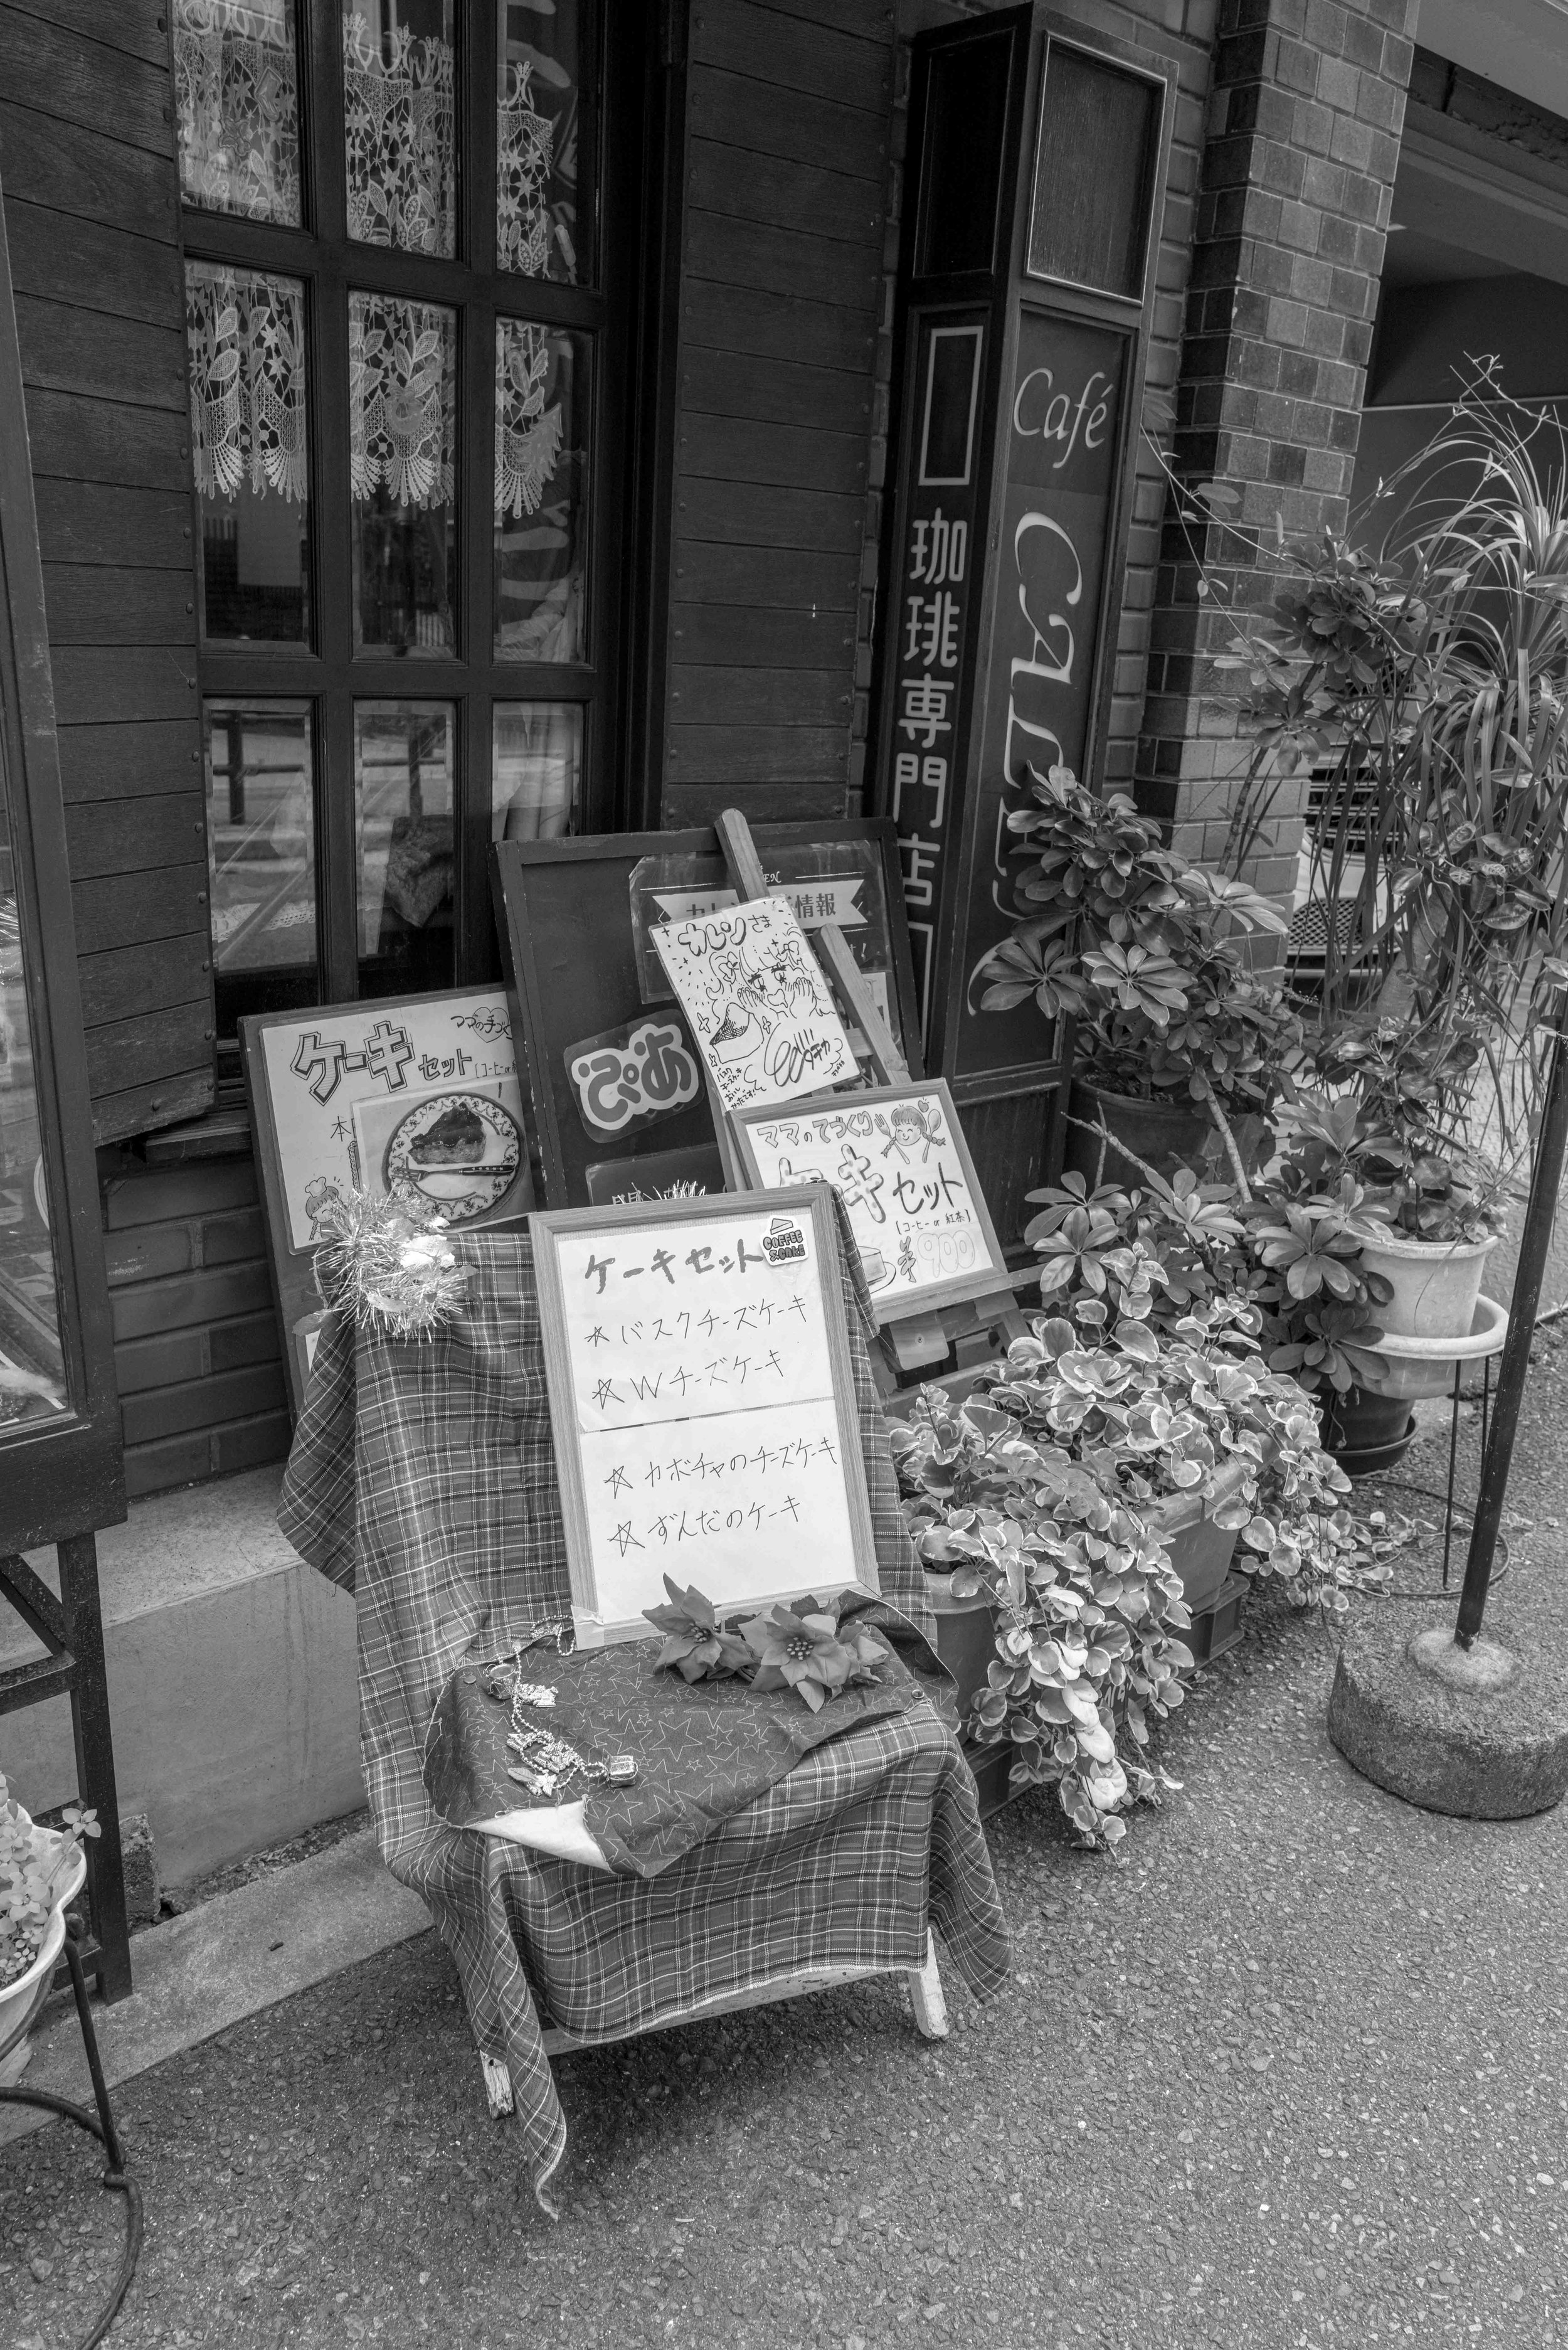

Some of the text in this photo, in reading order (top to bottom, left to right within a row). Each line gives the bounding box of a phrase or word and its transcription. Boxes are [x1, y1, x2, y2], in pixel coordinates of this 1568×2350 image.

[1014, 367, 1114, 469] Café
[893, 506, 968, 907] 珈琲専門店
[578, 1031, 692, 1123] ぴあ
[757, 1111, 874, 1148] ママのてづくり
[763, 1230, 803, 1250] COFFEE
[585, 1238, 763, 1294] ケーキセット
[621, 1295, 807, 1345] バスクチーズケーキ
[645, 1437, 837, 1487] カボチャのチーズケーキ
[647, 1495, 801, 1545] ずんだのケーキ
